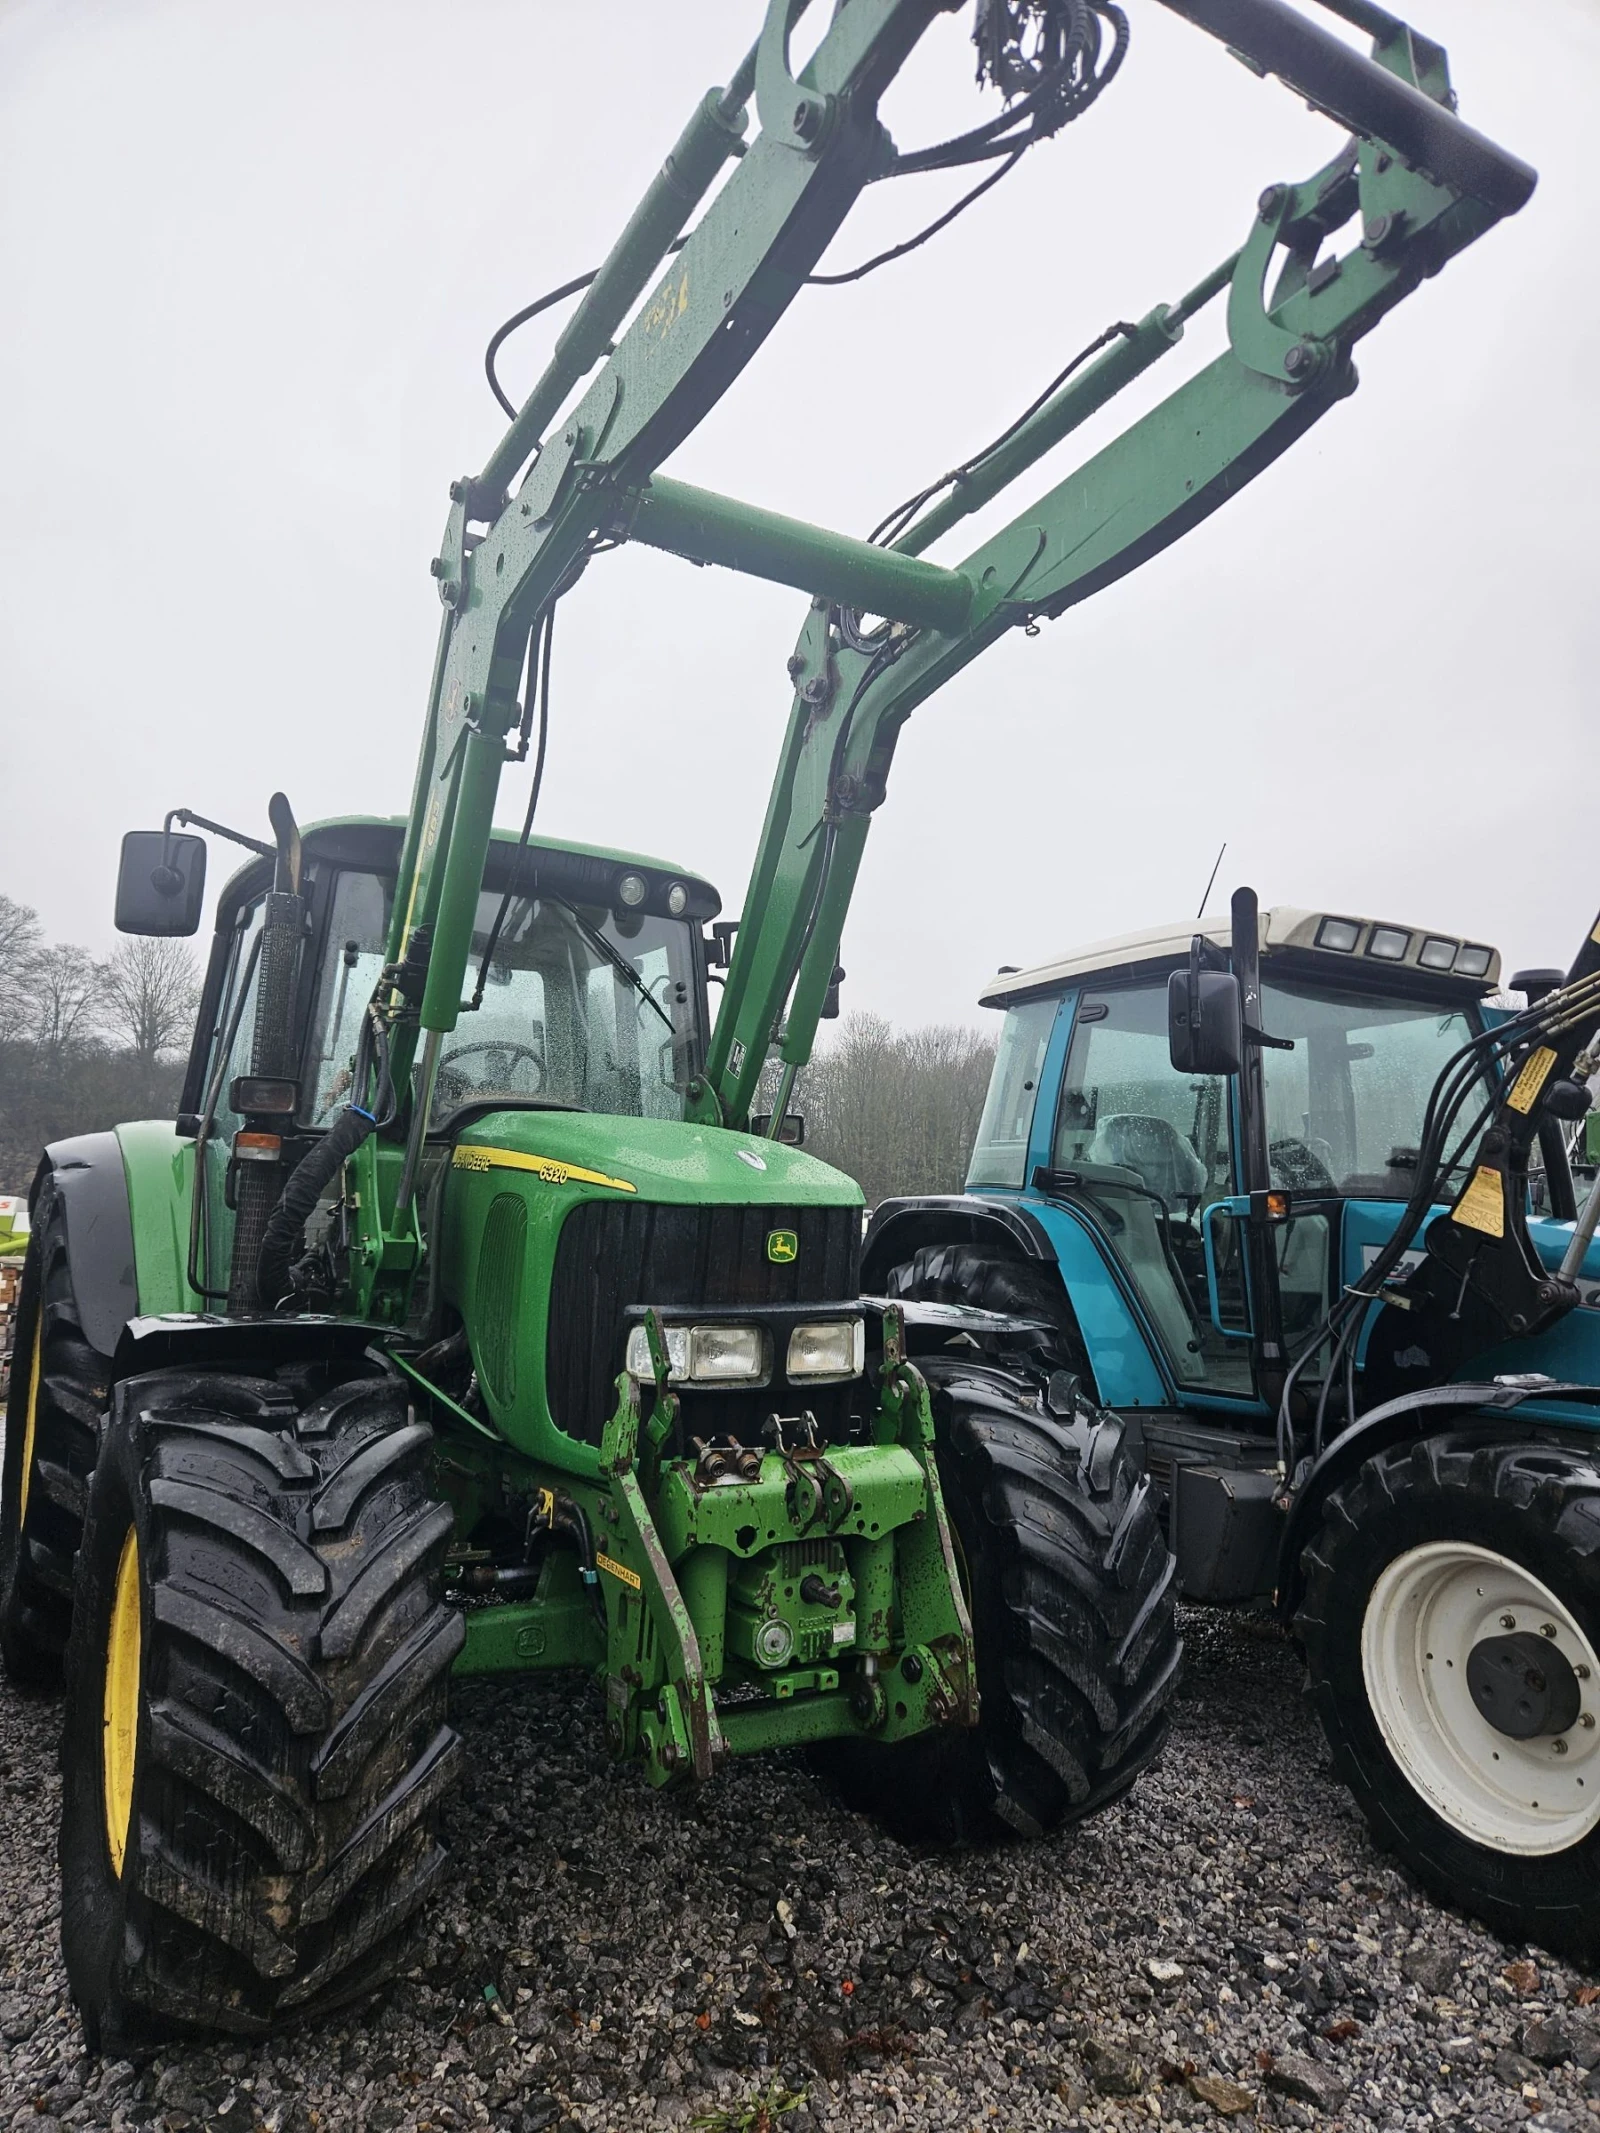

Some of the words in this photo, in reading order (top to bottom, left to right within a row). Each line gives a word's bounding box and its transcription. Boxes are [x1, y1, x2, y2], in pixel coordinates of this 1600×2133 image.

[467, 1150, 491, 1171] DEERE
[538, 1161, 569, 1184] 6320
[597, 1555, 640, 1586] DEGENHART
